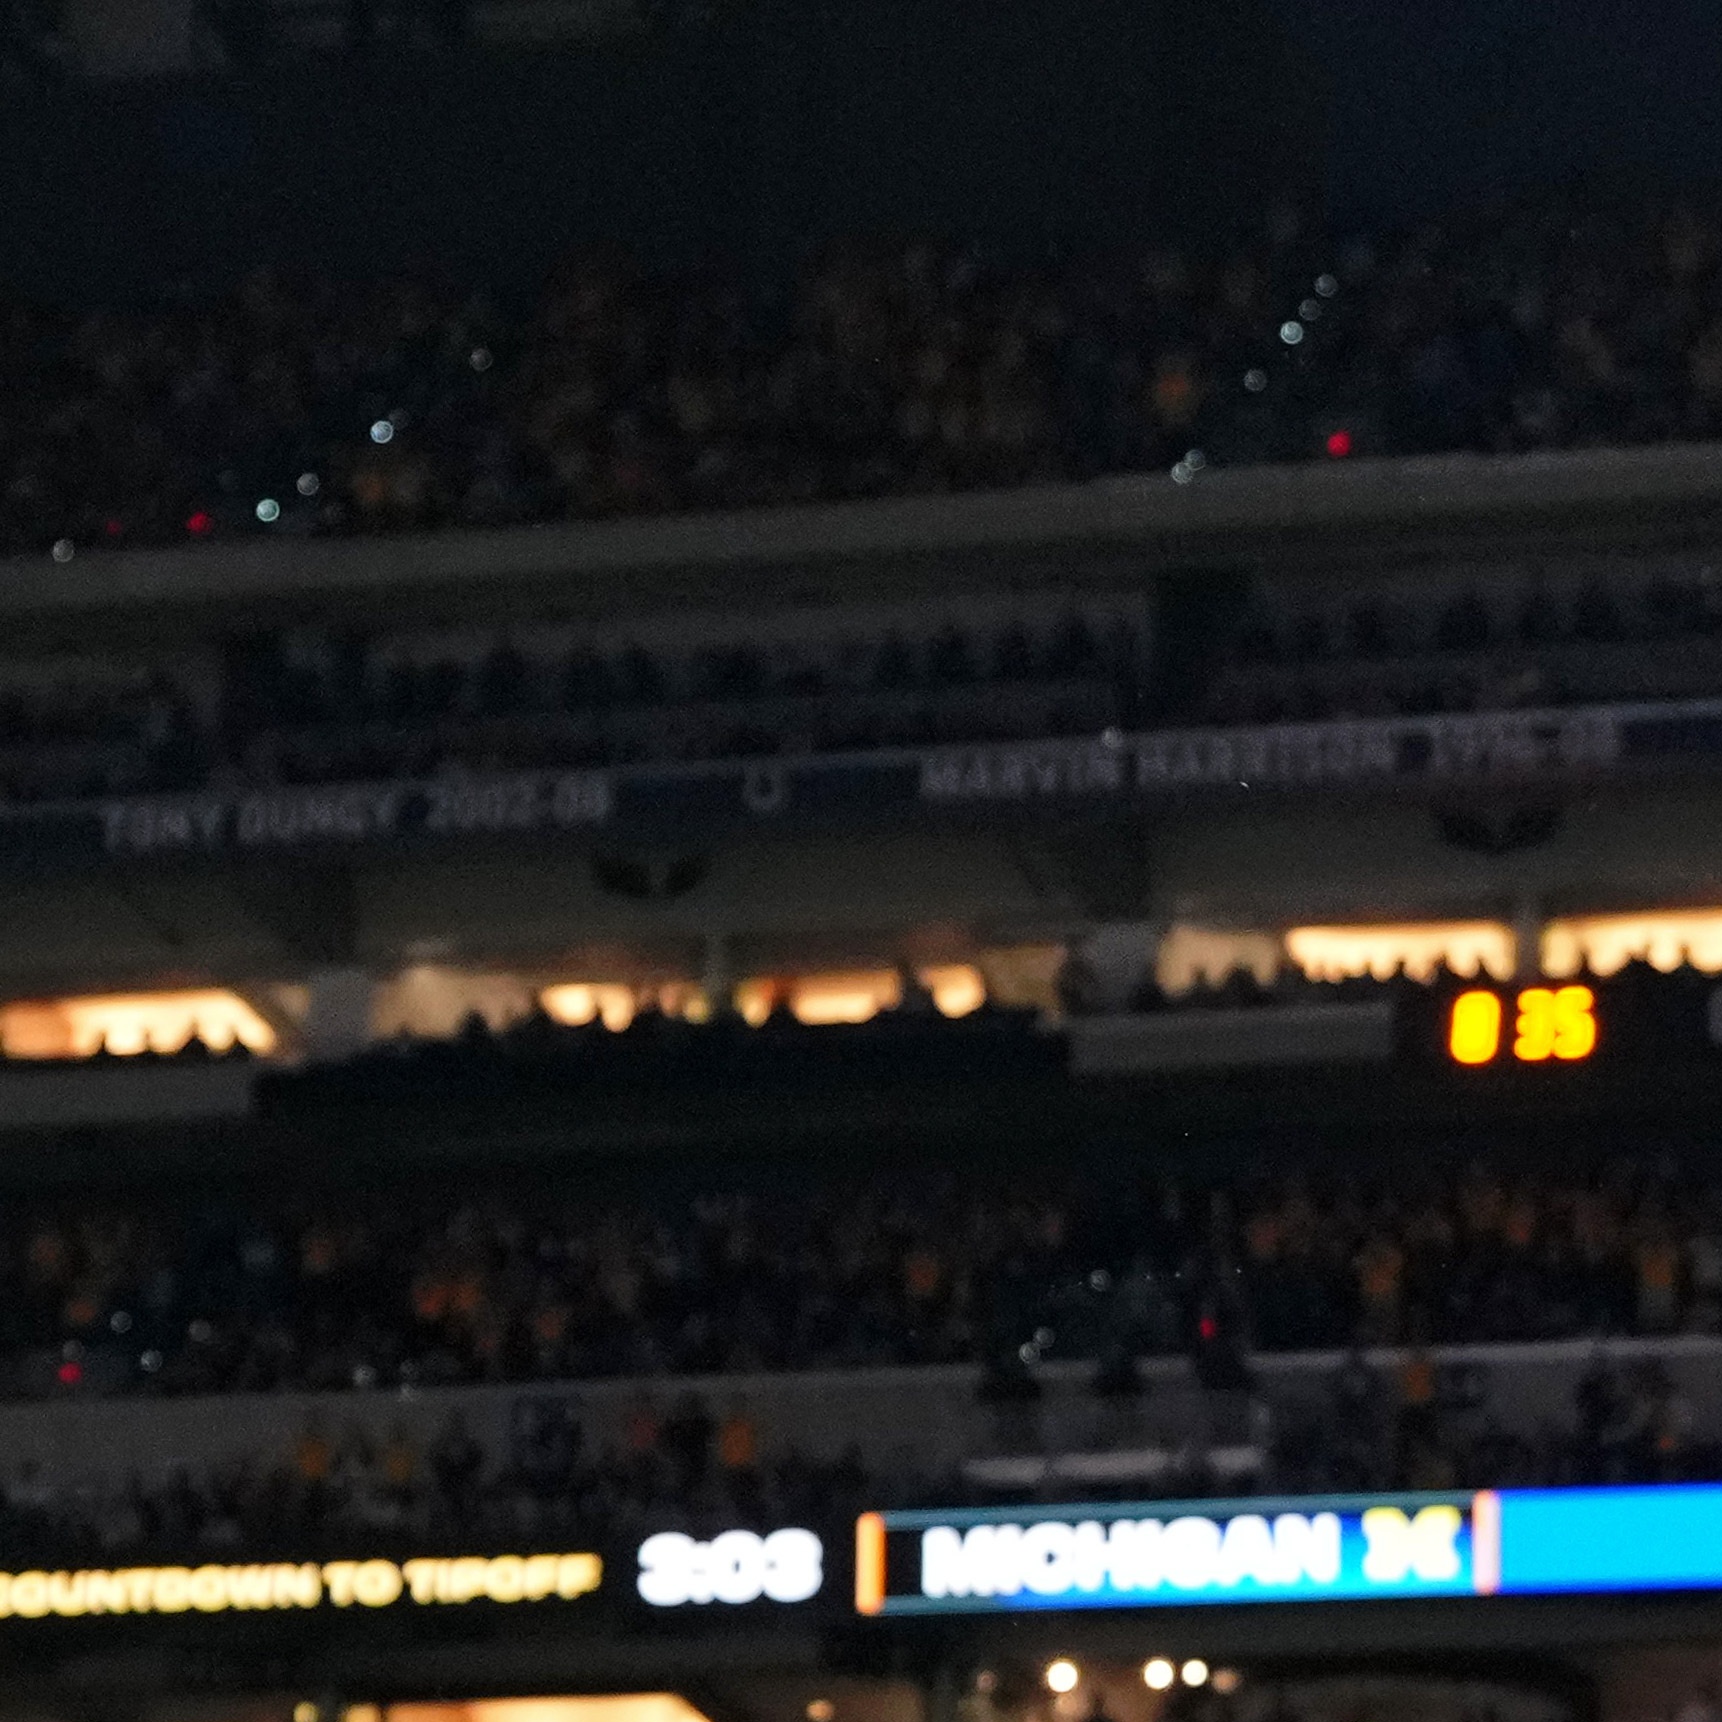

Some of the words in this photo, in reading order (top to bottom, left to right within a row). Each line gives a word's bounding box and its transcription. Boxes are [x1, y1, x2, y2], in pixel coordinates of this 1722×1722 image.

[102, 801, 220, 851] TONY
[0, 1565, 320, 1616] OUNTDOWN
[324, 1561, 401, 1605] TO
[404, 1553, 600, 1602] TIPOFF
[922, 1512, 1341, 1599] MICHIGAN
